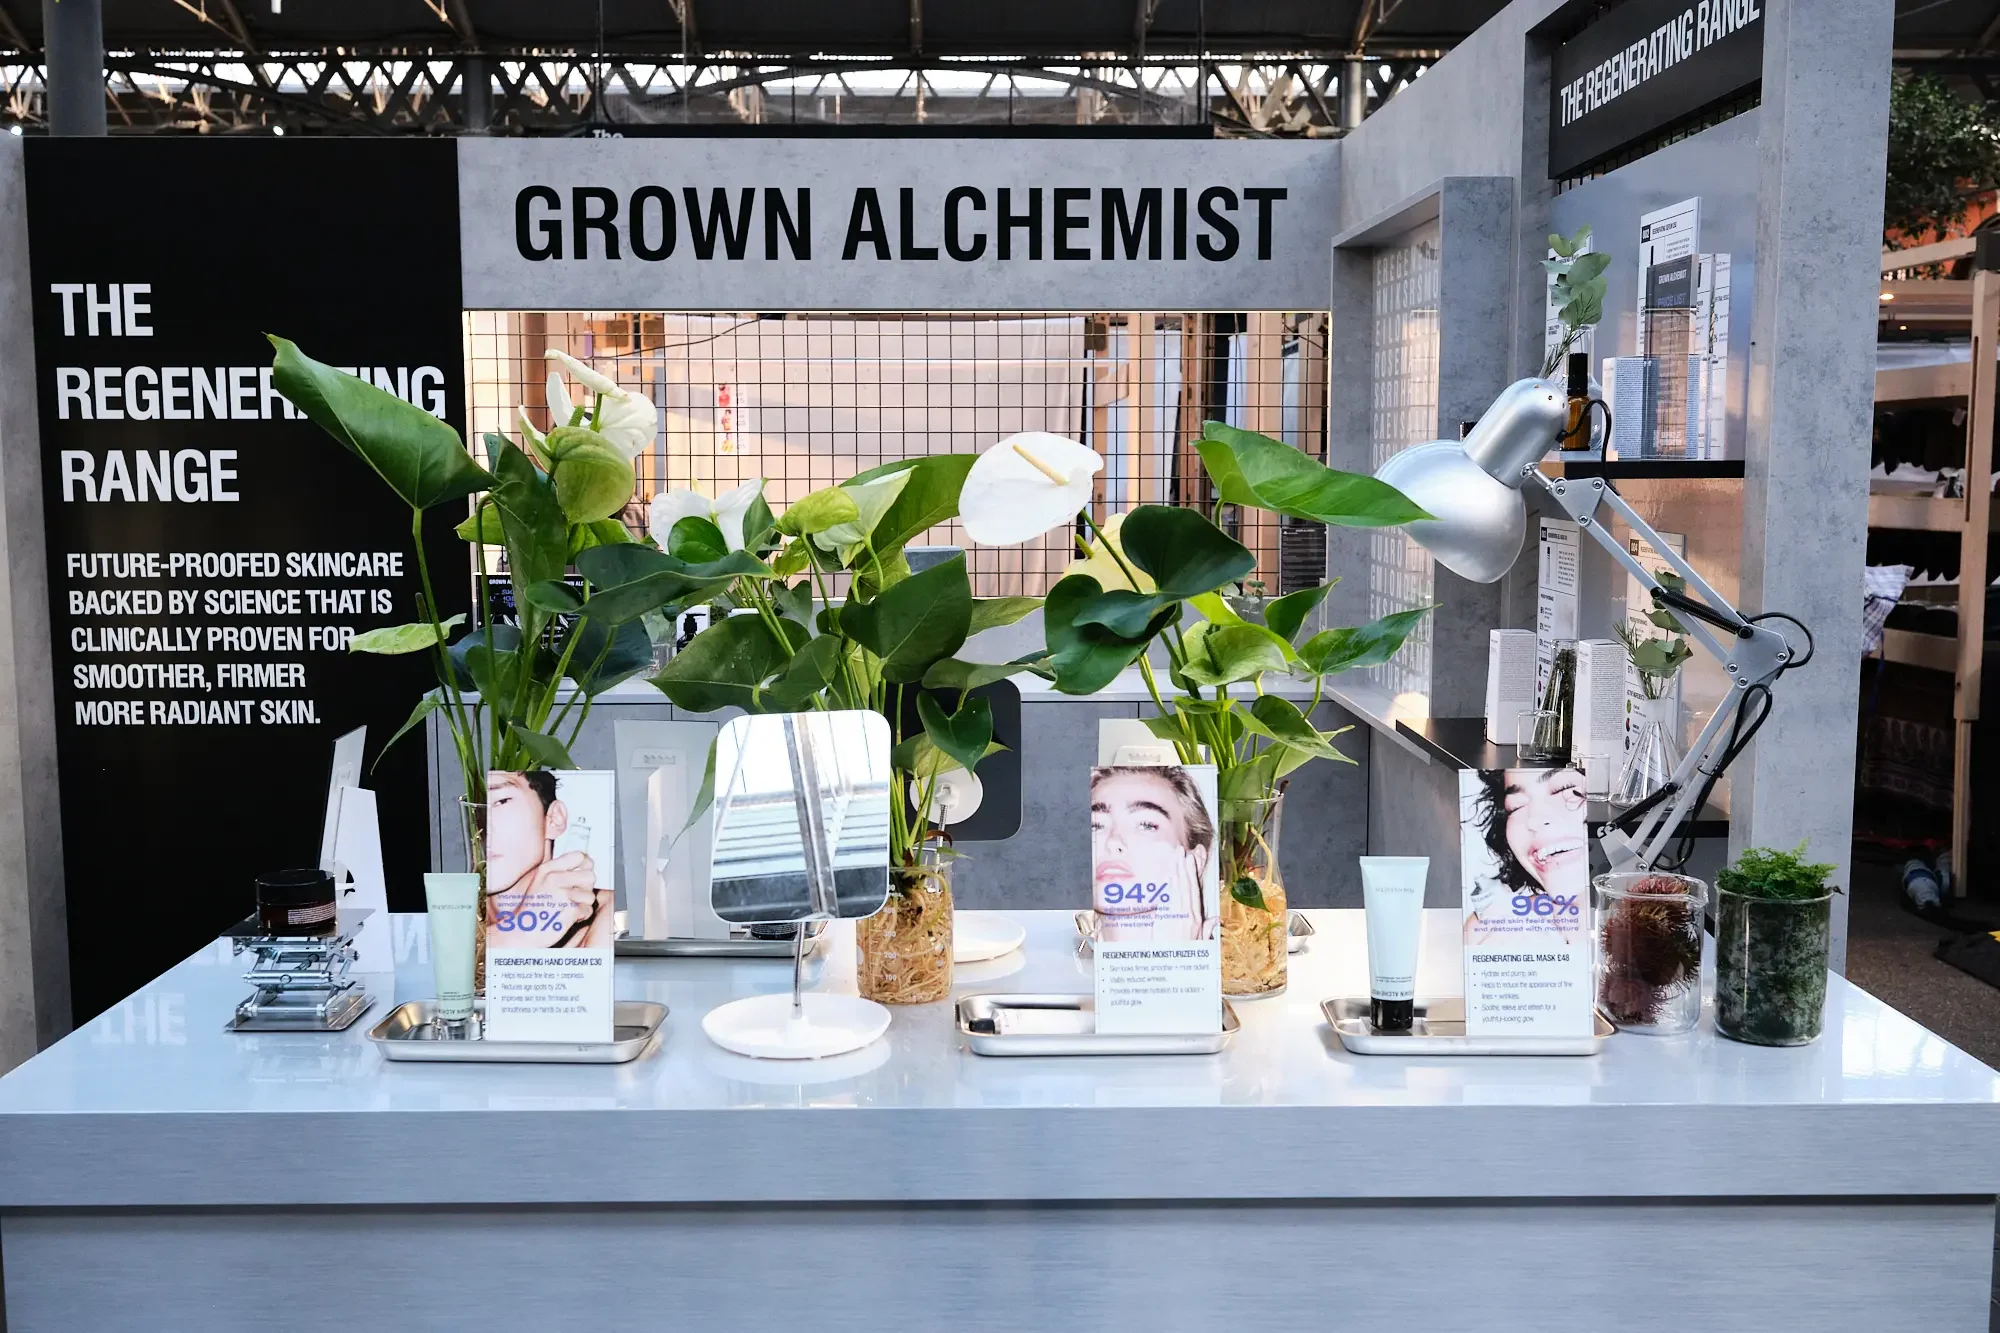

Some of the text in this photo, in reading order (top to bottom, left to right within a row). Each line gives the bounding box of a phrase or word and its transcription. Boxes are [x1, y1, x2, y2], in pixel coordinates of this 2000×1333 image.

[1560, 76, 1584, 127] THE
[1585, 8, 1694, 114] REGENERATING
[515, 185, 1288, 262] GROWN ALCHEMIST
[51, 283, 153, 336] THE
[60, 449, 240, 502] RANGE
[67, 552, 404, 578] FUTURE-PROOFED SKINCARE
[69, 589, 393, 615] BACKED BY SCIENCE THAT IS
[71, 626, 355, 652] CLINICALLY PROVEN FOR
[73, 663, 306, 692] SMOOTHER, FIRMER
[75, 699, 321, 725] MORE RADIANT SKIN.
[1103, 882, 1170, 904] 94%
[1512, 895, 1579, 916] 96%
[496, 910, 563, 932] 30%
[1154, 912, 1189, 920] hydrated
[494, 958, 602, 966] REGENERATING HAND CREAM £30
[1102, 951, 1151, 959] REGENERATING
[1152, 950, 1196, 958] MOISTURIZER
